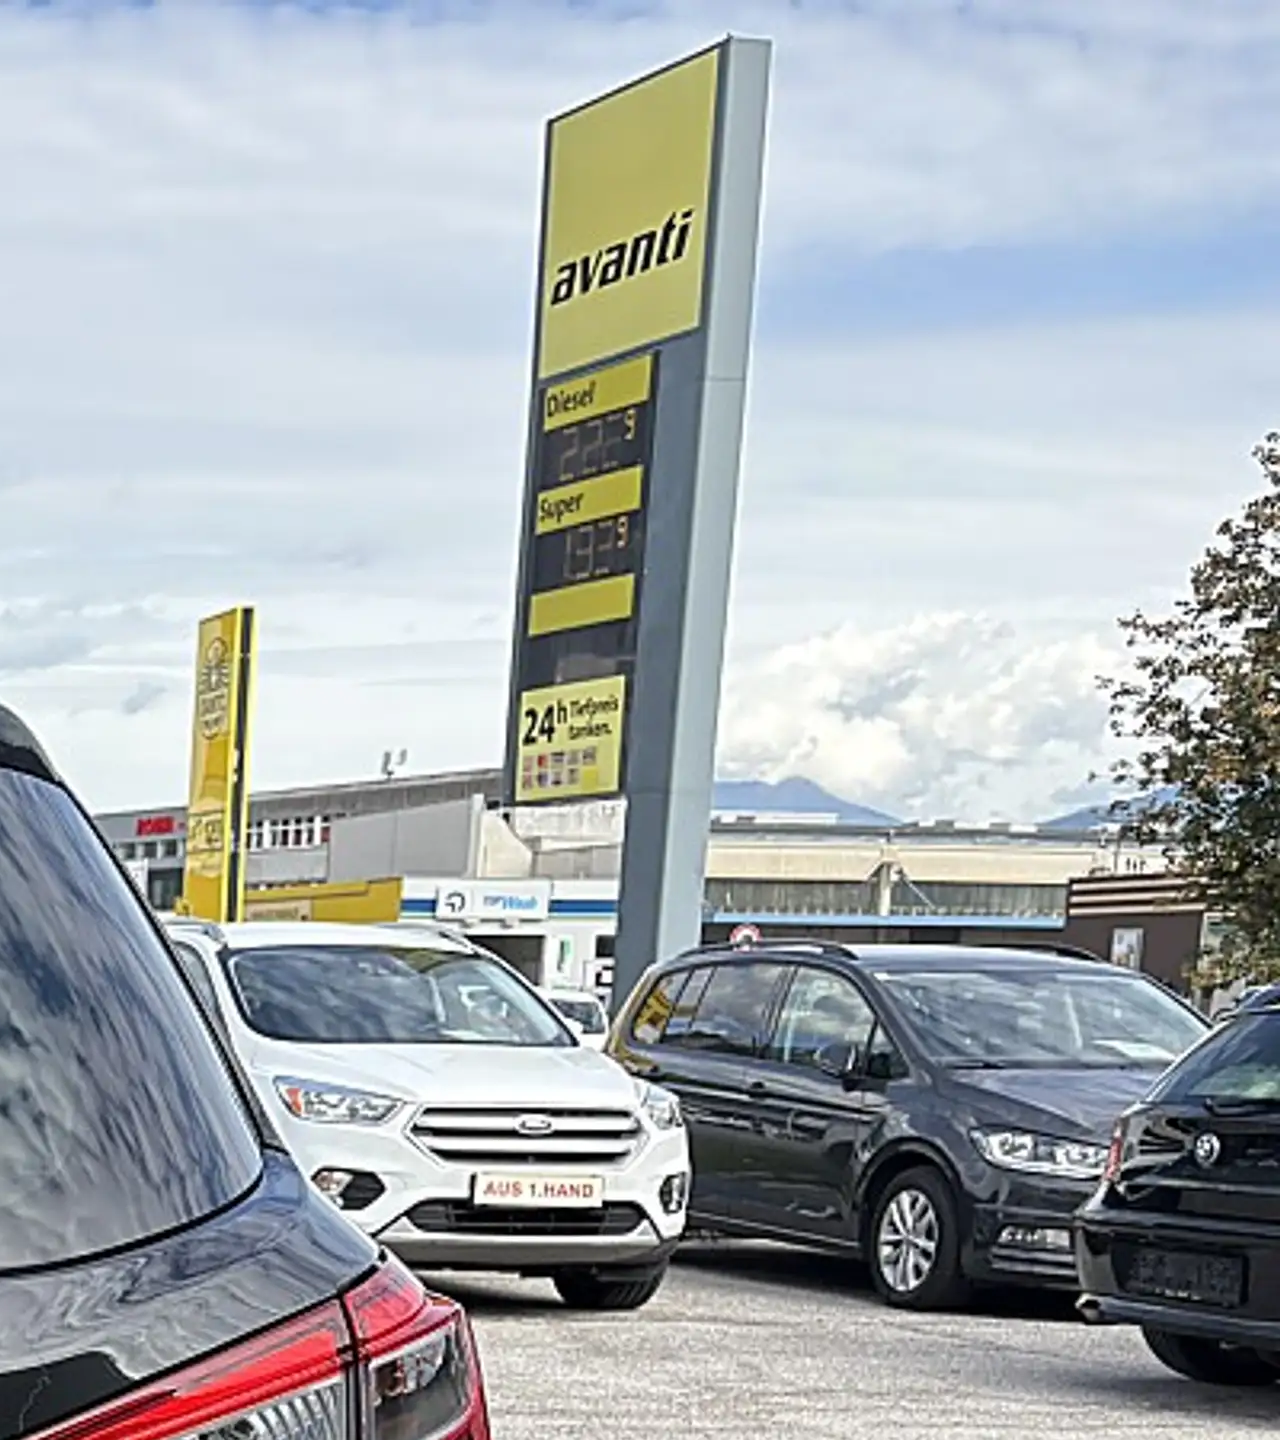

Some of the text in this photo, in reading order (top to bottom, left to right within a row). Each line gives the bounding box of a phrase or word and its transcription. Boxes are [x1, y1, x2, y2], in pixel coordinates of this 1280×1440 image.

[550, 208, 695, 306] avanti
[546, 380, 597, 417] Diesel
[539, 493, 584, 523] Super
[483, 1180, 523, 1197] AUS
